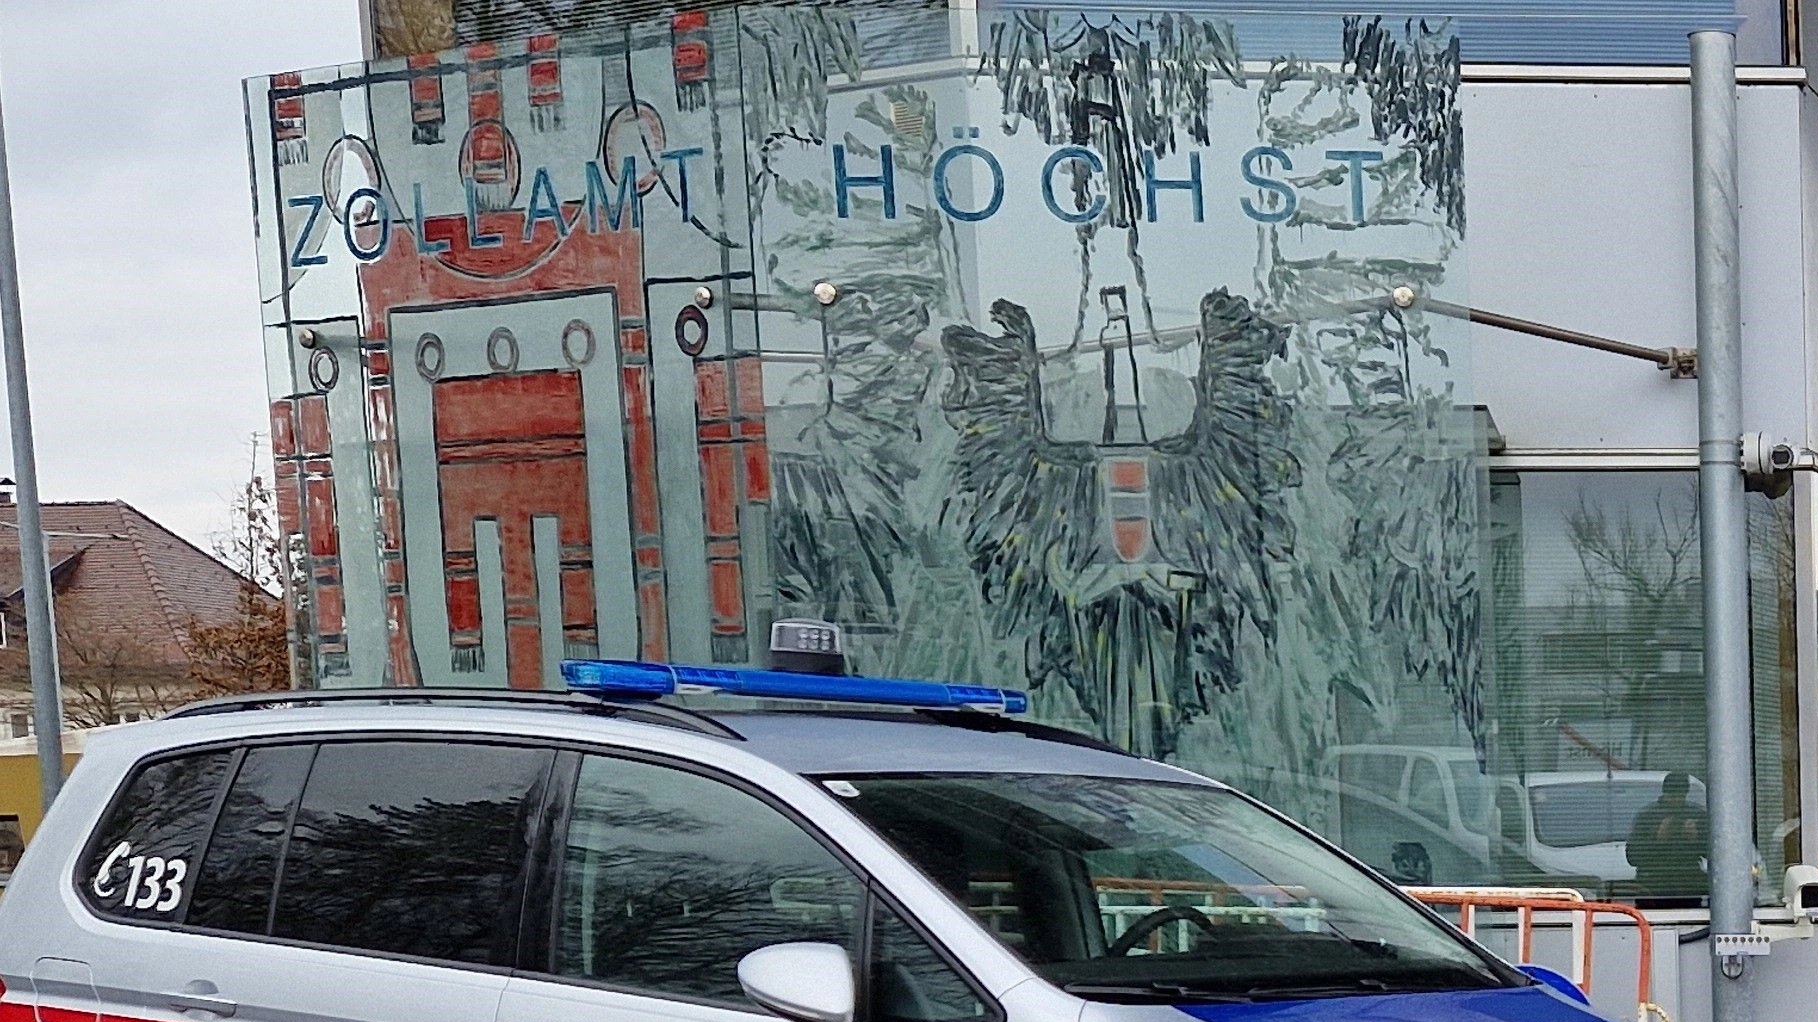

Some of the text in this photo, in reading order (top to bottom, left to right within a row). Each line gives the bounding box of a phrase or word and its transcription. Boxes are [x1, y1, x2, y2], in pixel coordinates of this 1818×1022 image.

[288, 127, 1384, 268] ZOLLAMT HÖCHST
[124, 856, 187, 911] 133
